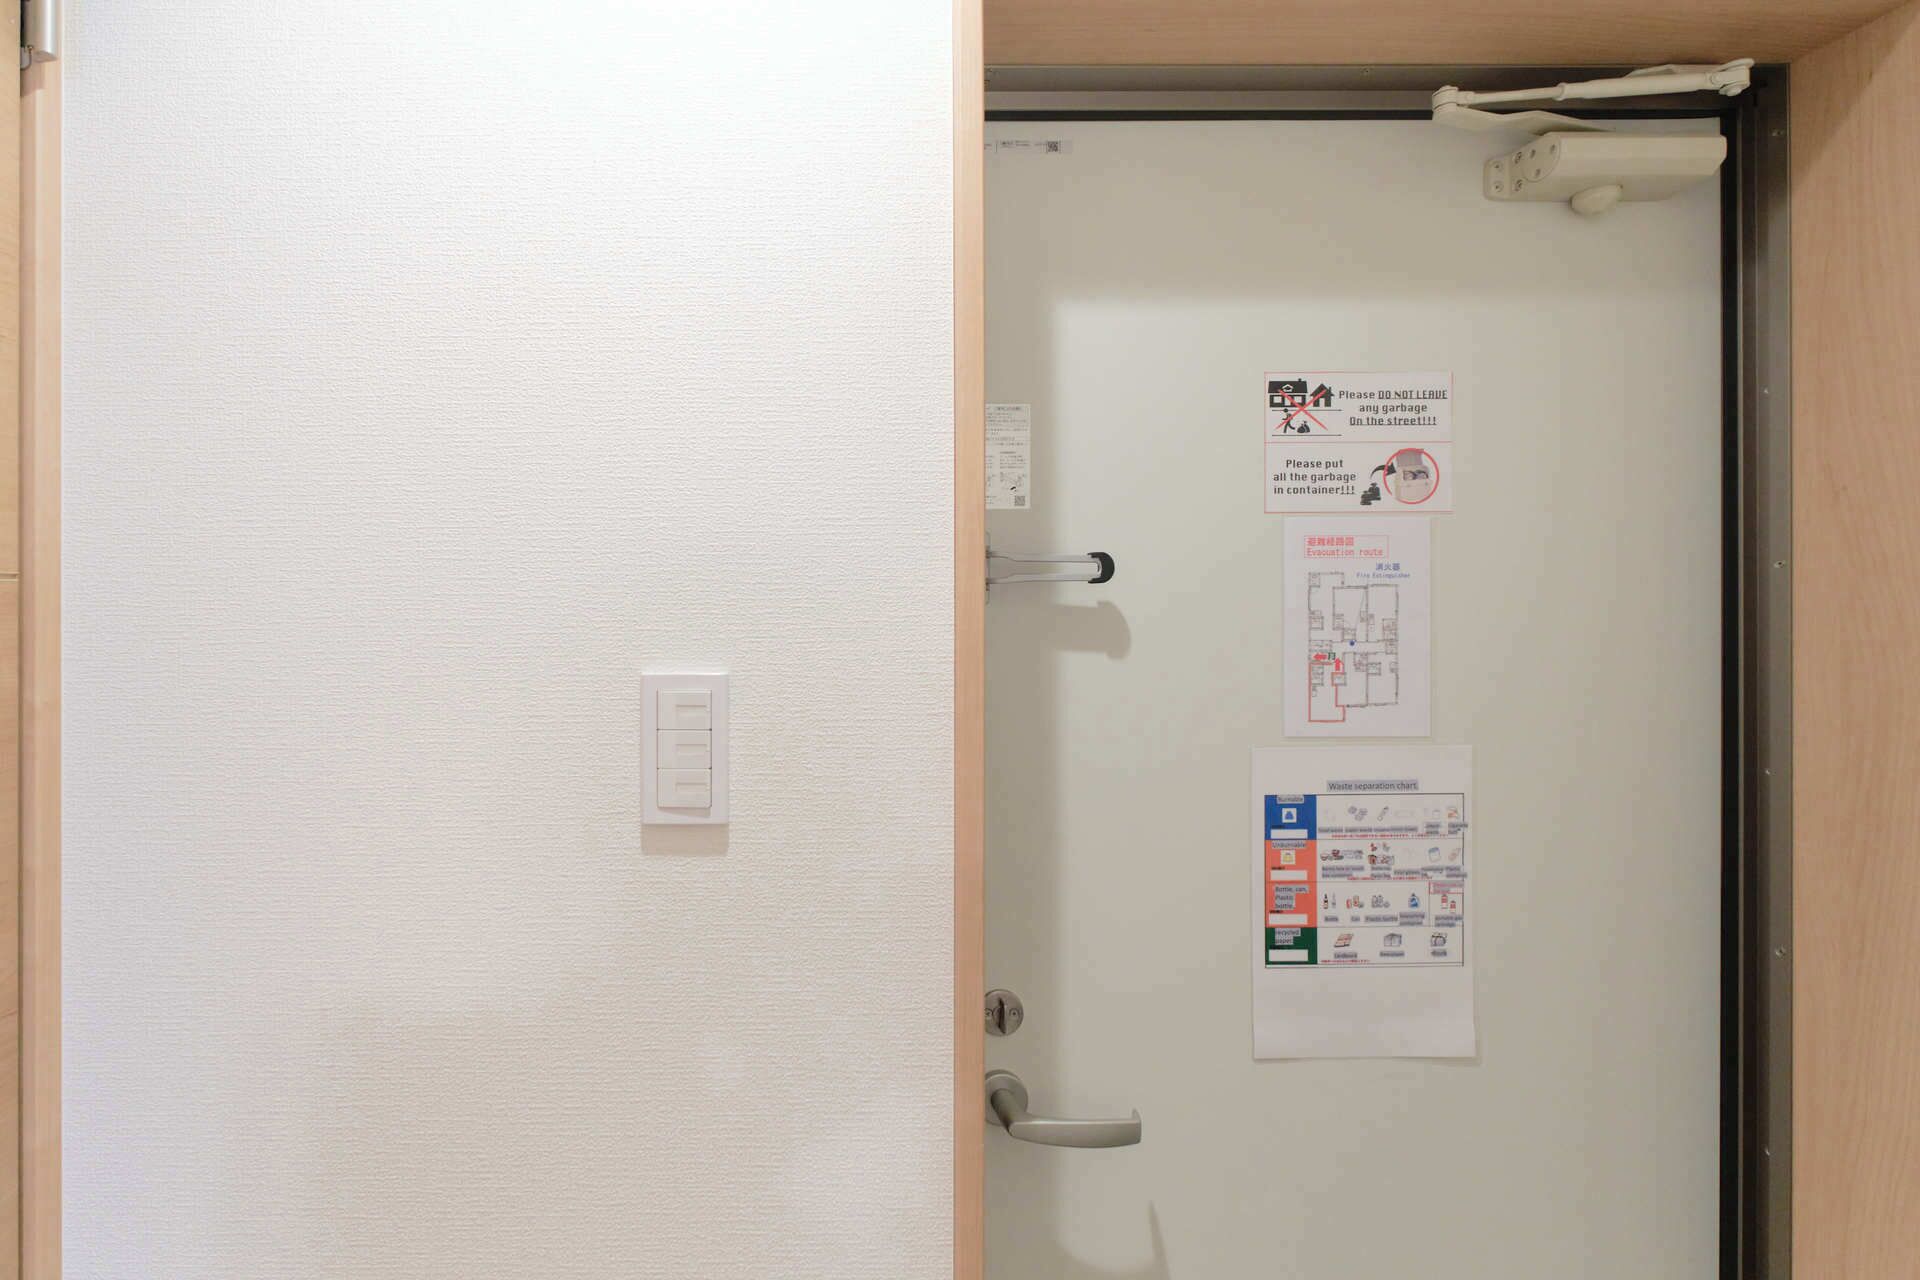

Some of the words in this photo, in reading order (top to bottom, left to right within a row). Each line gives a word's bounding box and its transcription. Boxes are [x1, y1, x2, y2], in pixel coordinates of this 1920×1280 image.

[1338, 390, 1376, 399] Please
[1377, 390, 1392, 400] DO
[1394, 390, 1414, 400] NOT
[1359, 404, 1379, 414] any
[1382, 403, 1428, 414] garbage
[1349, 417, 1363, 426] On
[1366, 417, 1384, 426] the
[1387, 417, 1437, 426] street!!!
[1285, 459, 1322, 469] Please
[1325, 459, 1344, 470] put
[1273, 472, 1287, 481] all
[1290, 472, 1308, 481] the
[1311, 472, 1356, 483] garbage
[1274, 486, 1284, 495] in
[1286, 486, 1355, 495] container!!!
[1307, 548, 1355, 556] Evacuation
[1359, 548, 1383, 556] route
[1376, 562, 1401, 571] 消火器
[1328, 782, 1353, 790] Waste
[1354, 782, 1395, 792] separation
